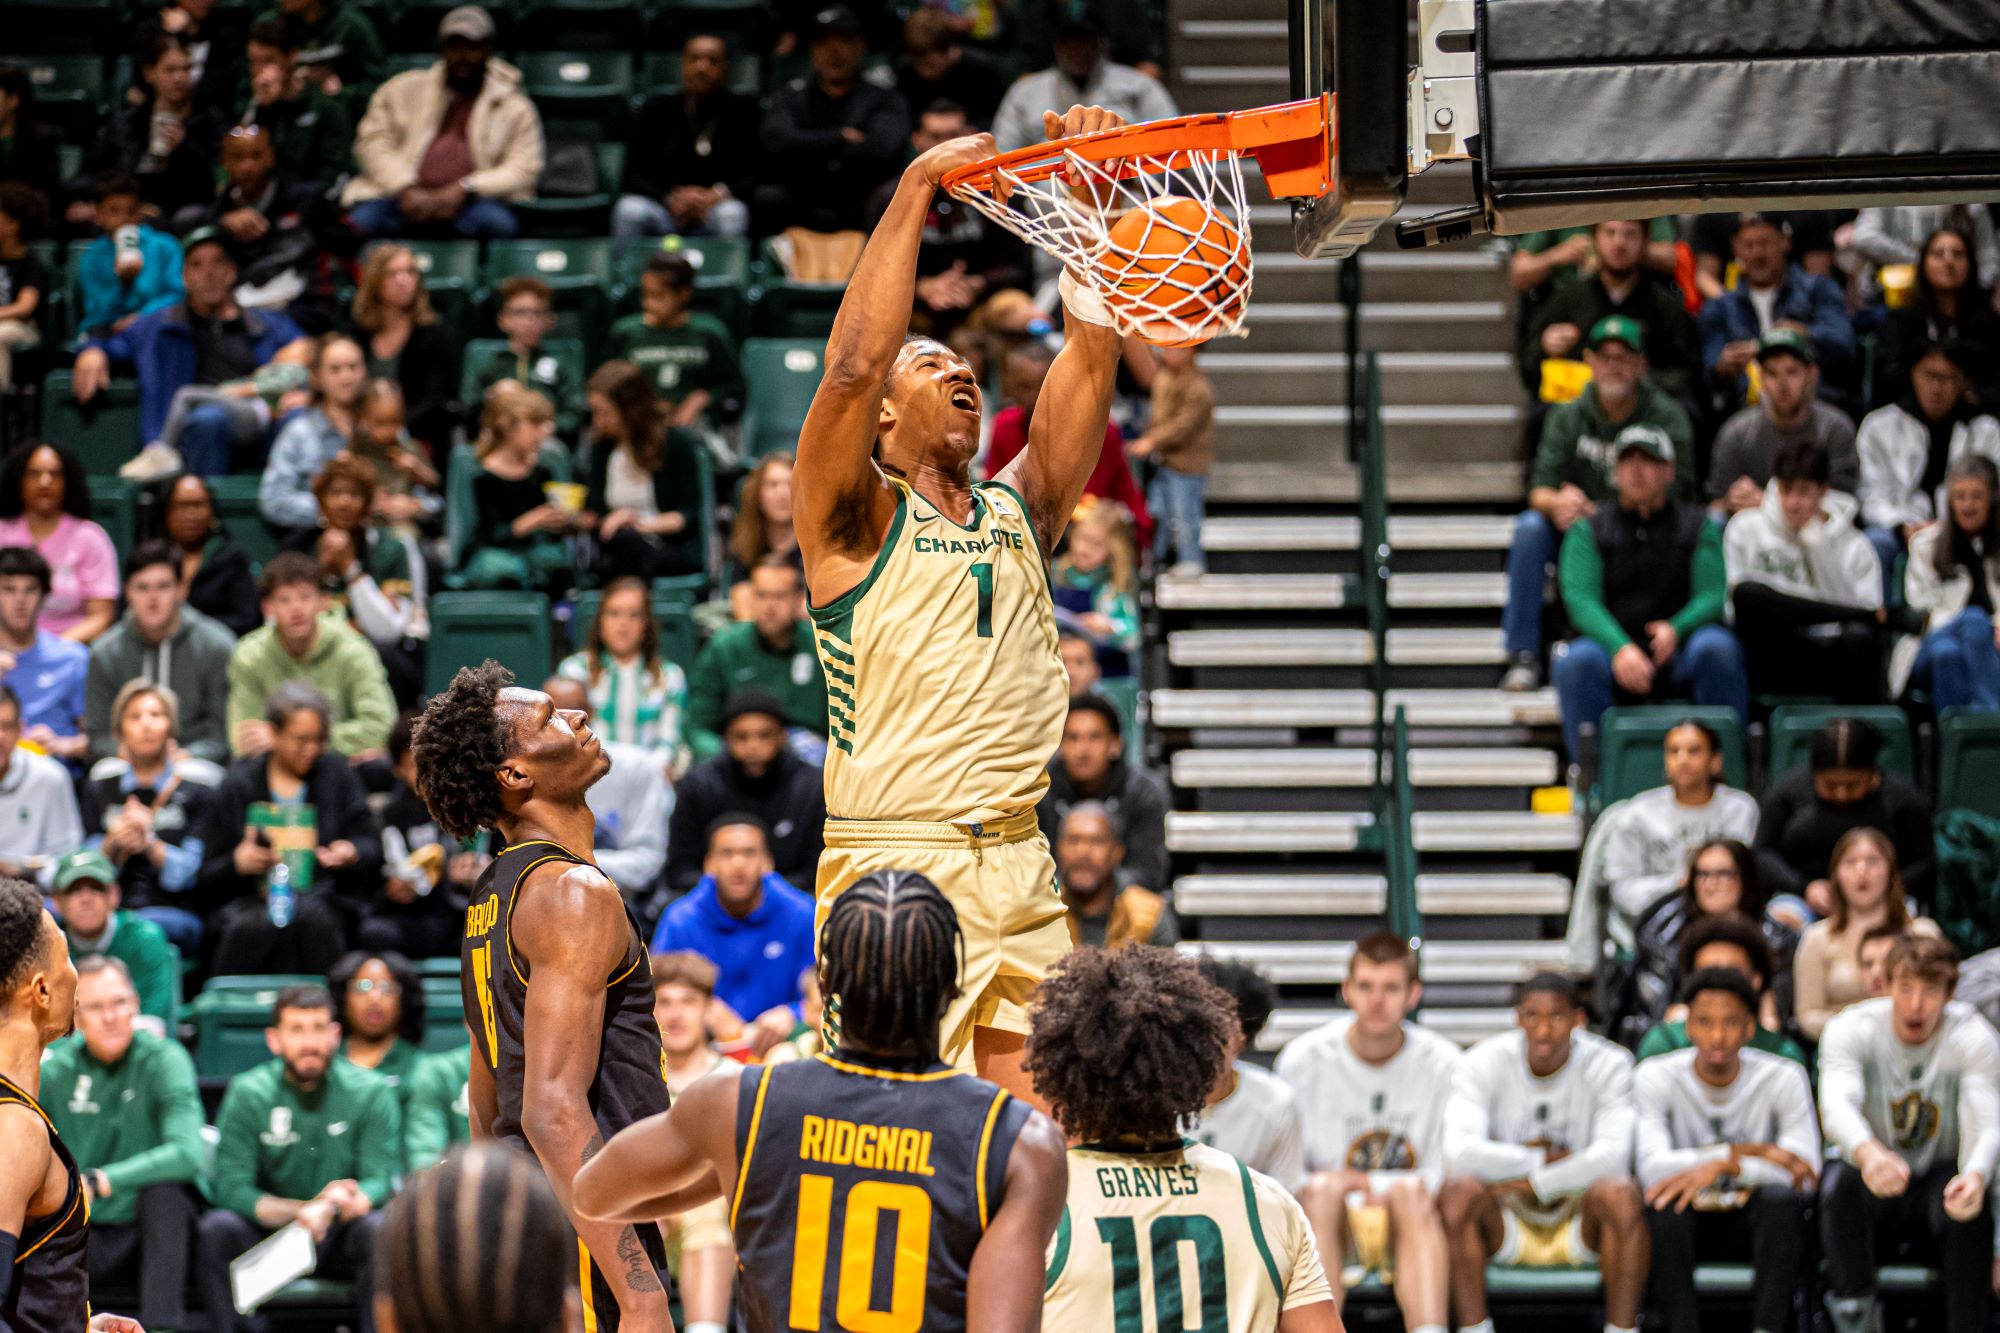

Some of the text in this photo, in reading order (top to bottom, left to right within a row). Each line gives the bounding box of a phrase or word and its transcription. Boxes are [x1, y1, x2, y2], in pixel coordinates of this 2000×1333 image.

[969, 563, 994, 638] 1
[800, 1115, 935, 1176] RIDGNAL
[1096, 1164, 1198, 1198] GRAVES
[789, 1173, 932, 1333] 10
[1094, 1214, 1229, 1333] 10
